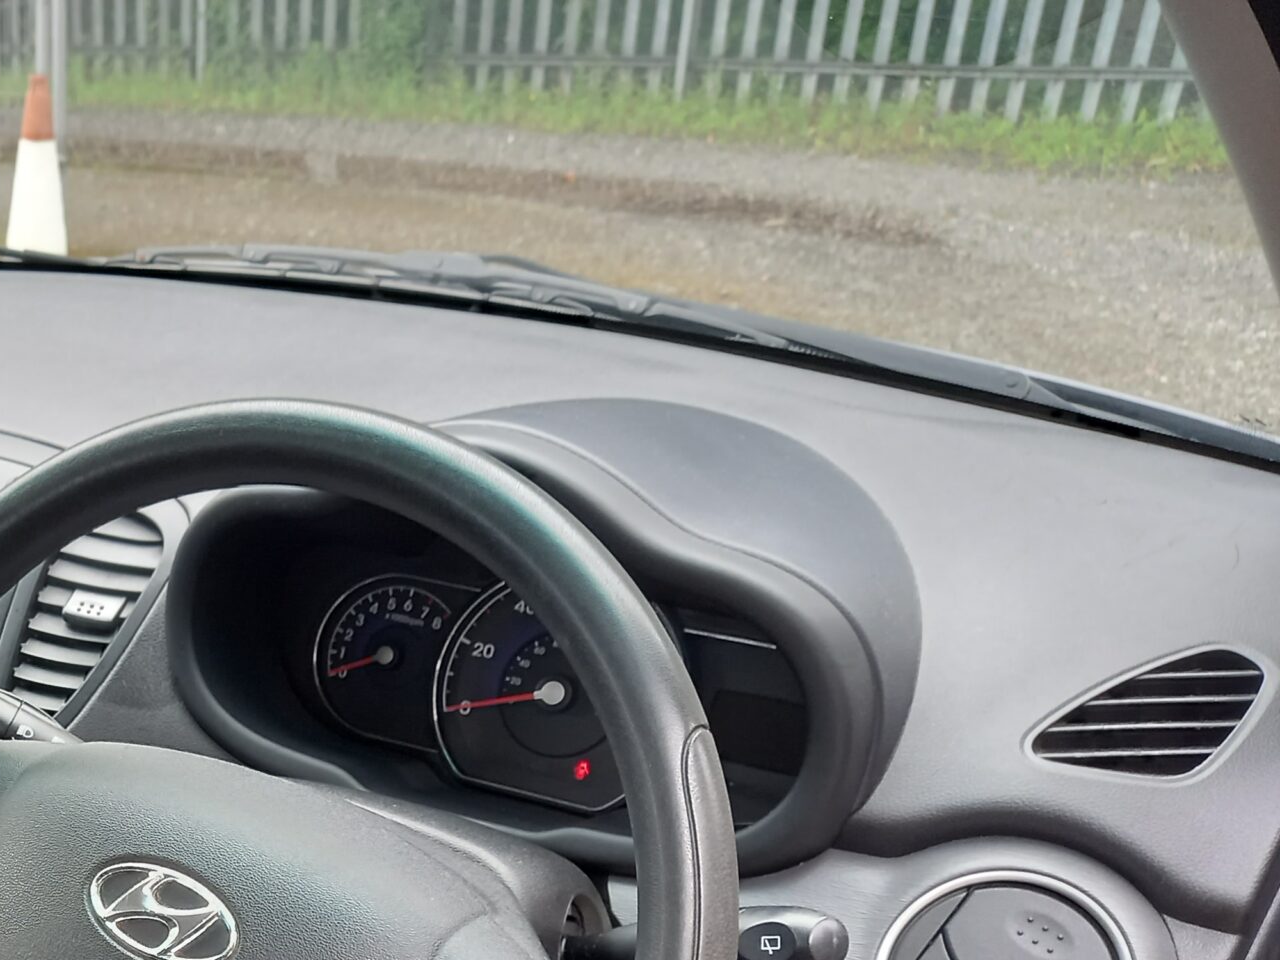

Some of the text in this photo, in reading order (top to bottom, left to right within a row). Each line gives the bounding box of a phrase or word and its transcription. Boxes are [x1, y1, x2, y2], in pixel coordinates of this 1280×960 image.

[369, 602, 379, 614] 4
[403, 599, 413, 612] 6
[421, 606, 430, 619] 7
[355, 613, 365, 626] 3
[432, 616, 442, 630] 8
[344, 628, 354, 641] 2
[472, 642, 495, 659] 20
